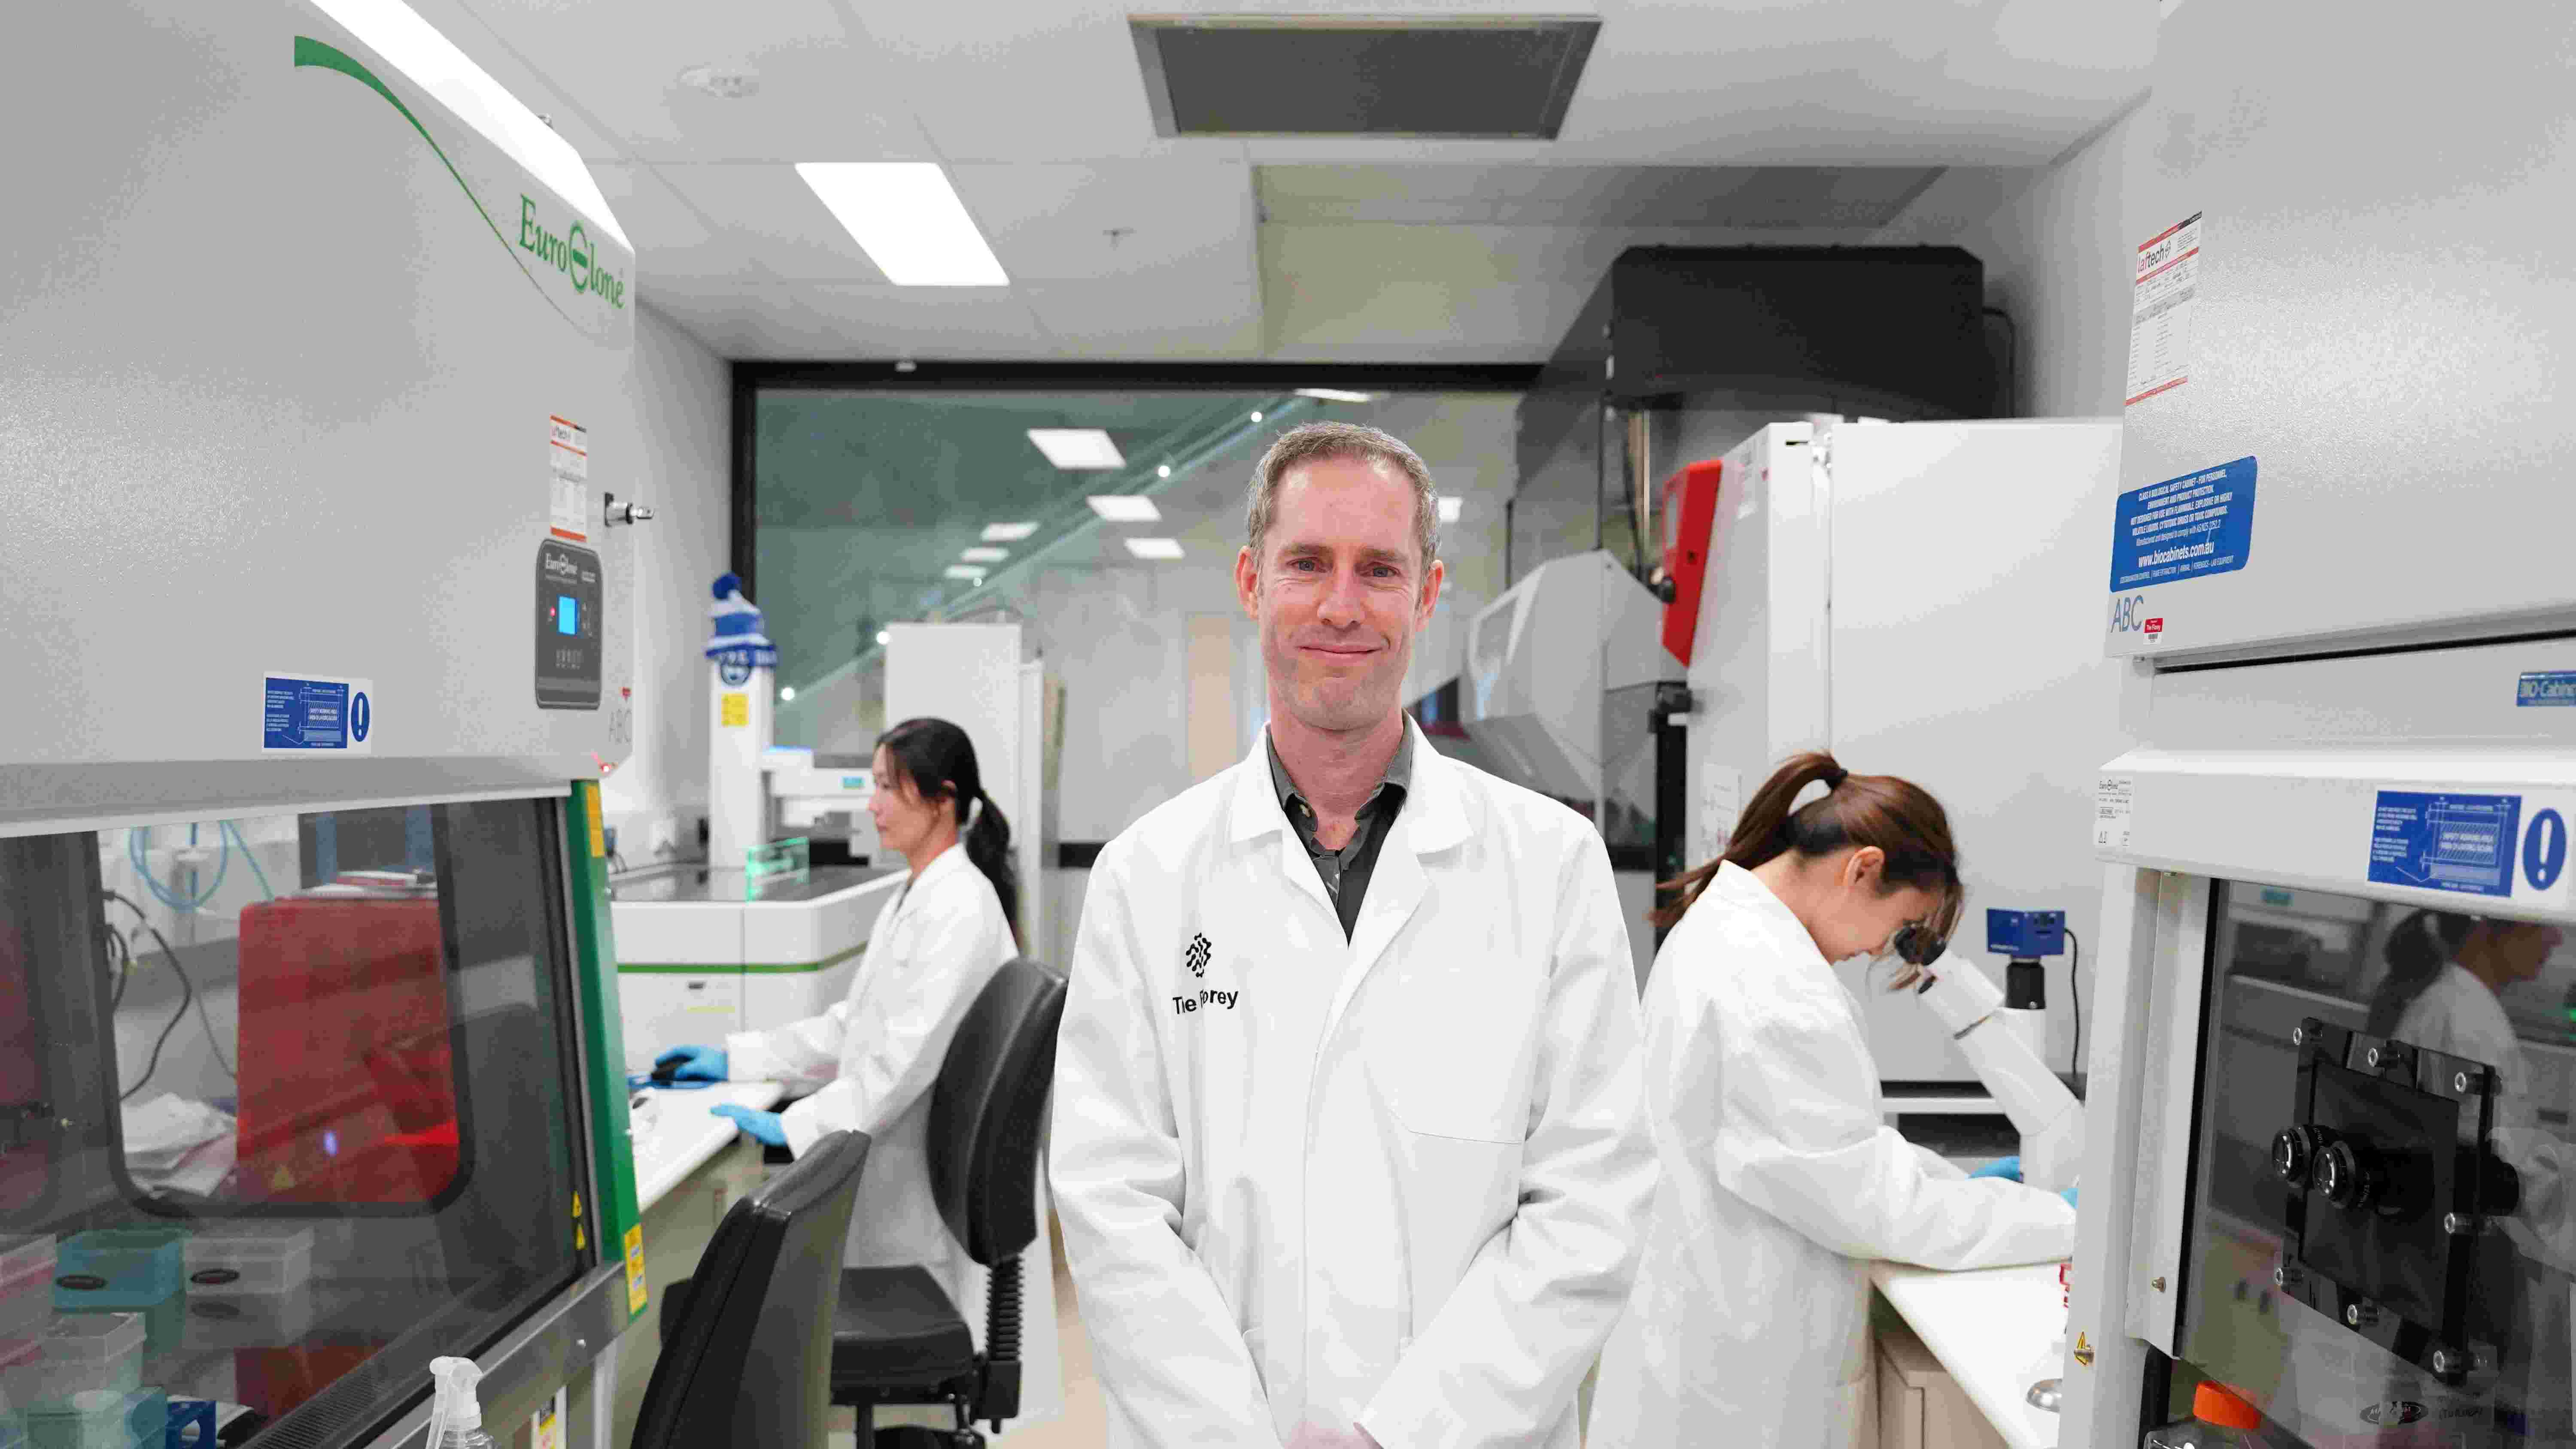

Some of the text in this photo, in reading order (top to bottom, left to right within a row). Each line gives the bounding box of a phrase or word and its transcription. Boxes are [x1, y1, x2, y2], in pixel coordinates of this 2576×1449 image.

[519, 193, 625, 309] EuroClone
[2139, 542, 2214, 567] www.biocabinets.com.au
[2111, 594, 2144, 633] ABC
